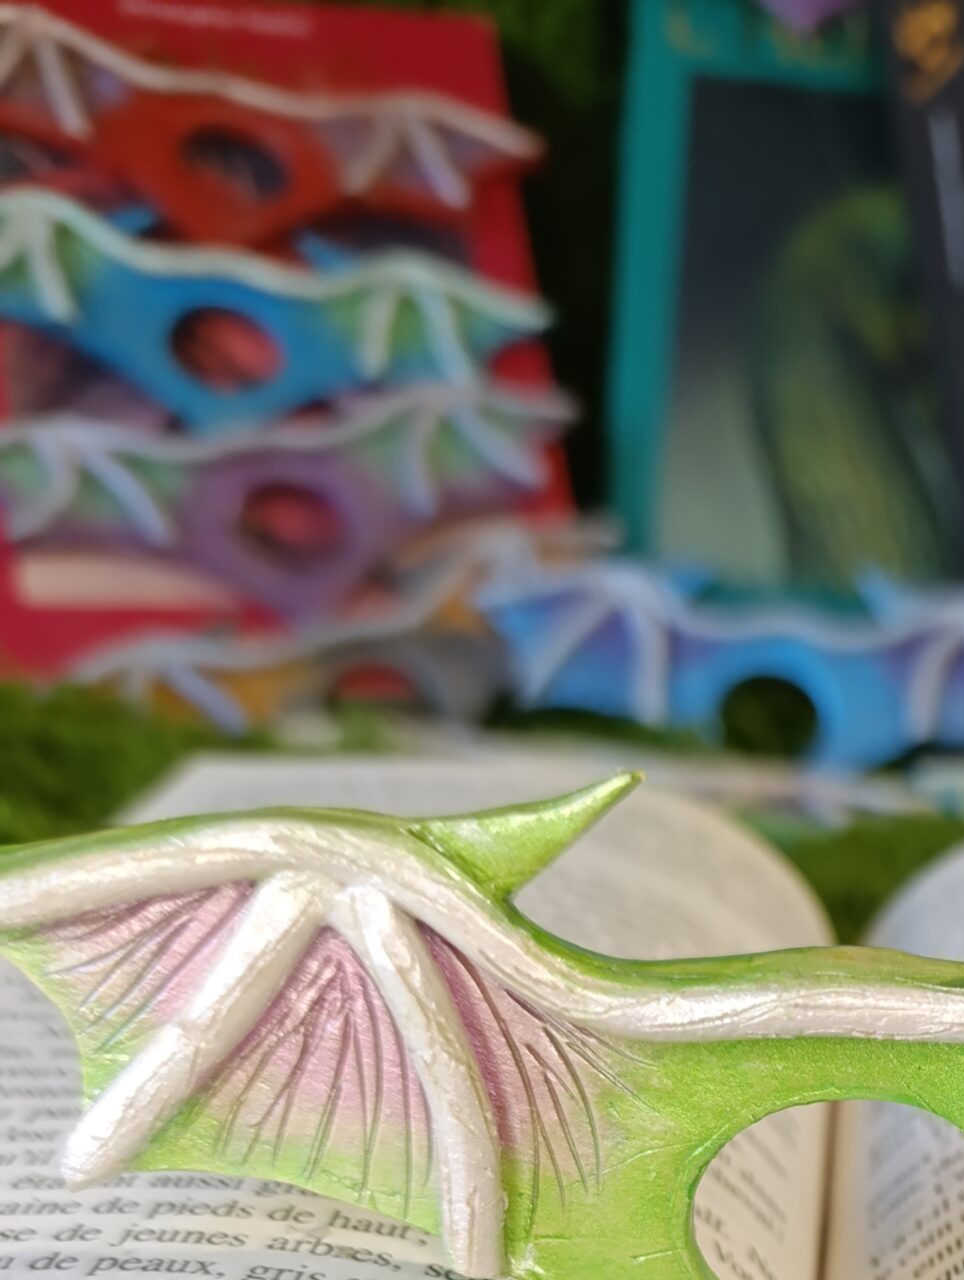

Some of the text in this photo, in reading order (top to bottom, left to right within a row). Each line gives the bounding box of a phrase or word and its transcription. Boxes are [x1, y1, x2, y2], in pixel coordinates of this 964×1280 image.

[0, 1197, 82, 1215] aine
[91, 1196, 140, 1215] de
[145, 1197, 256, 1219] pieds
[267, 1204, 315, 1224] de
[0, 1227, 38, 1242] se
[53, 1222, 102, 1242] de
[108, 1223, 249, 1248] jeunes
[28, 1251, 79, 1271] de
[86, 1255, 226, 1279] peaux,
